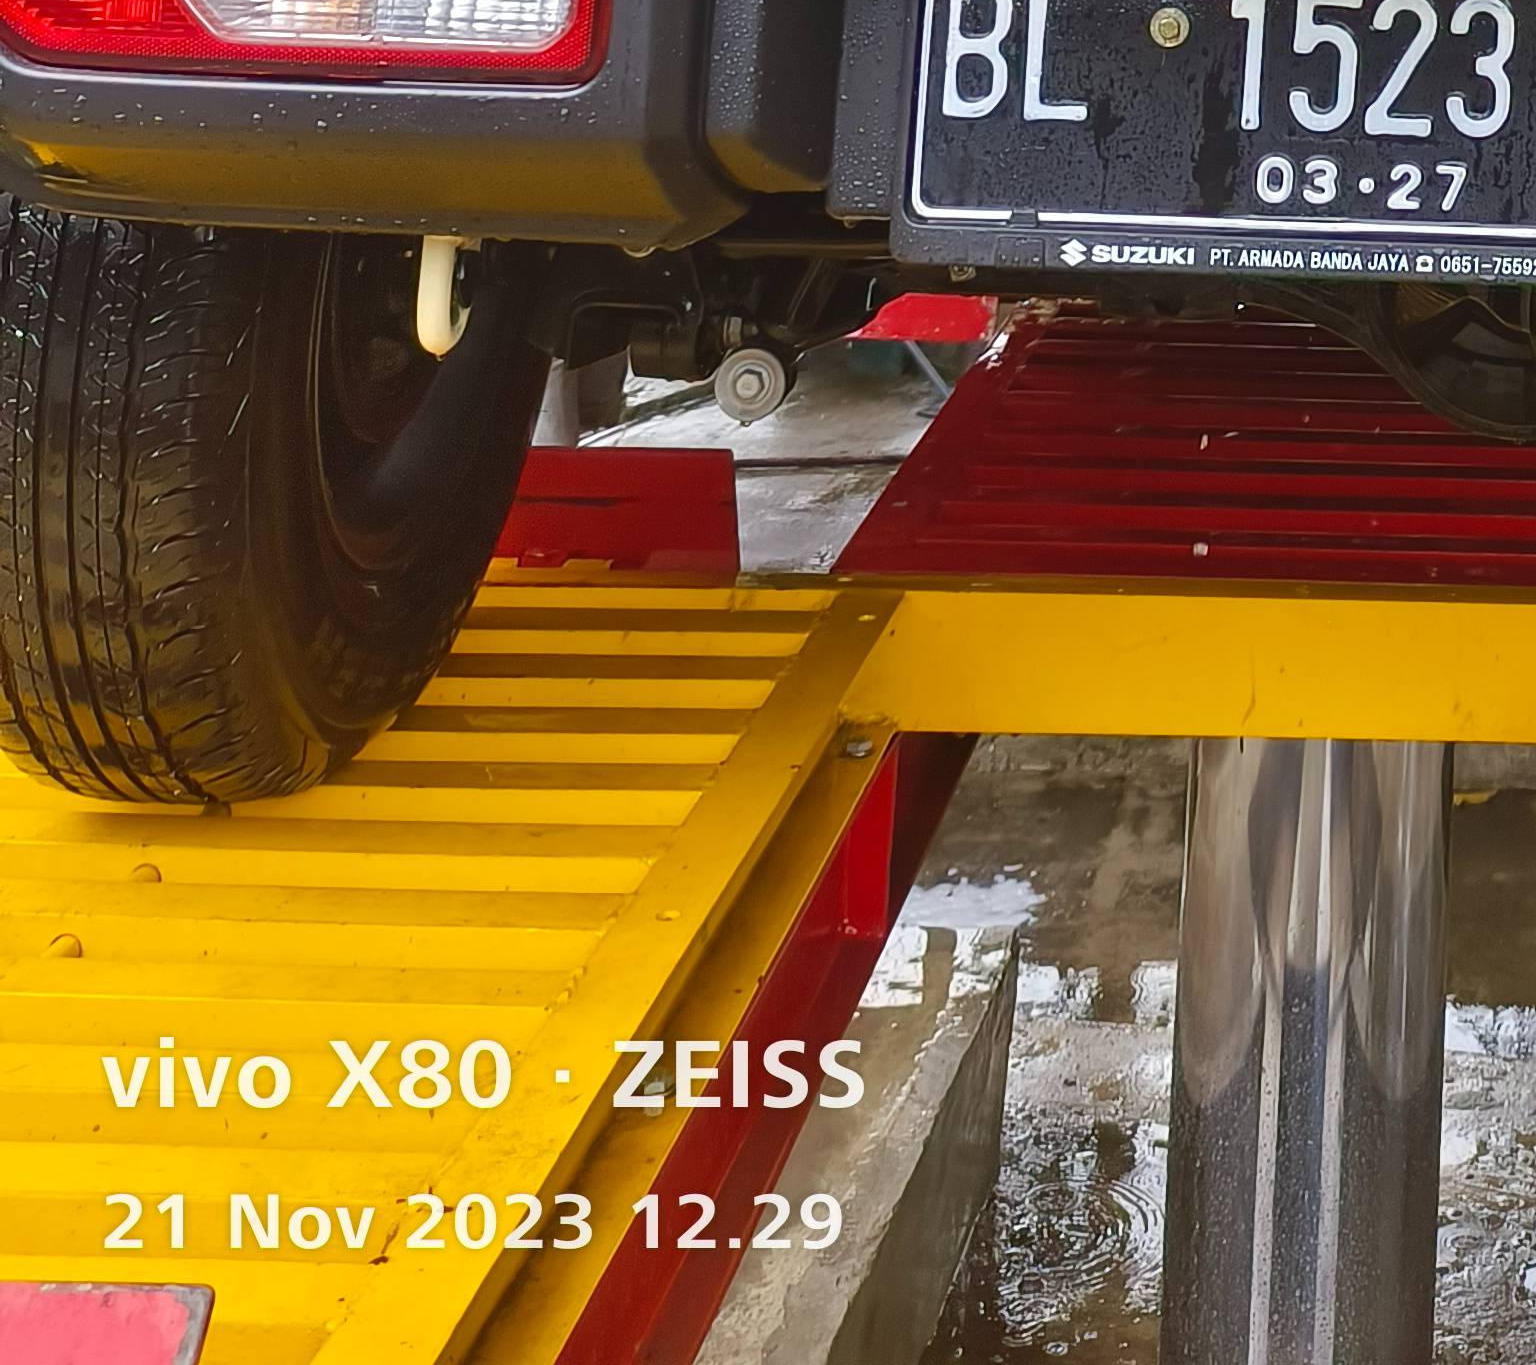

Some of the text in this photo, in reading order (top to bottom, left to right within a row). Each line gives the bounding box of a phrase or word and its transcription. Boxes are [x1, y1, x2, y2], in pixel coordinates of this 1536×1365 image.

[1090, 244, 1195, 266] SUZUKI
[1209, 248, 1234, 267] PT.
[1237, 249, 1305, 270] ARMADA
[1309, 252, 1364, 272] BANDA
[1367, 253, 1410, 273] JAYA
